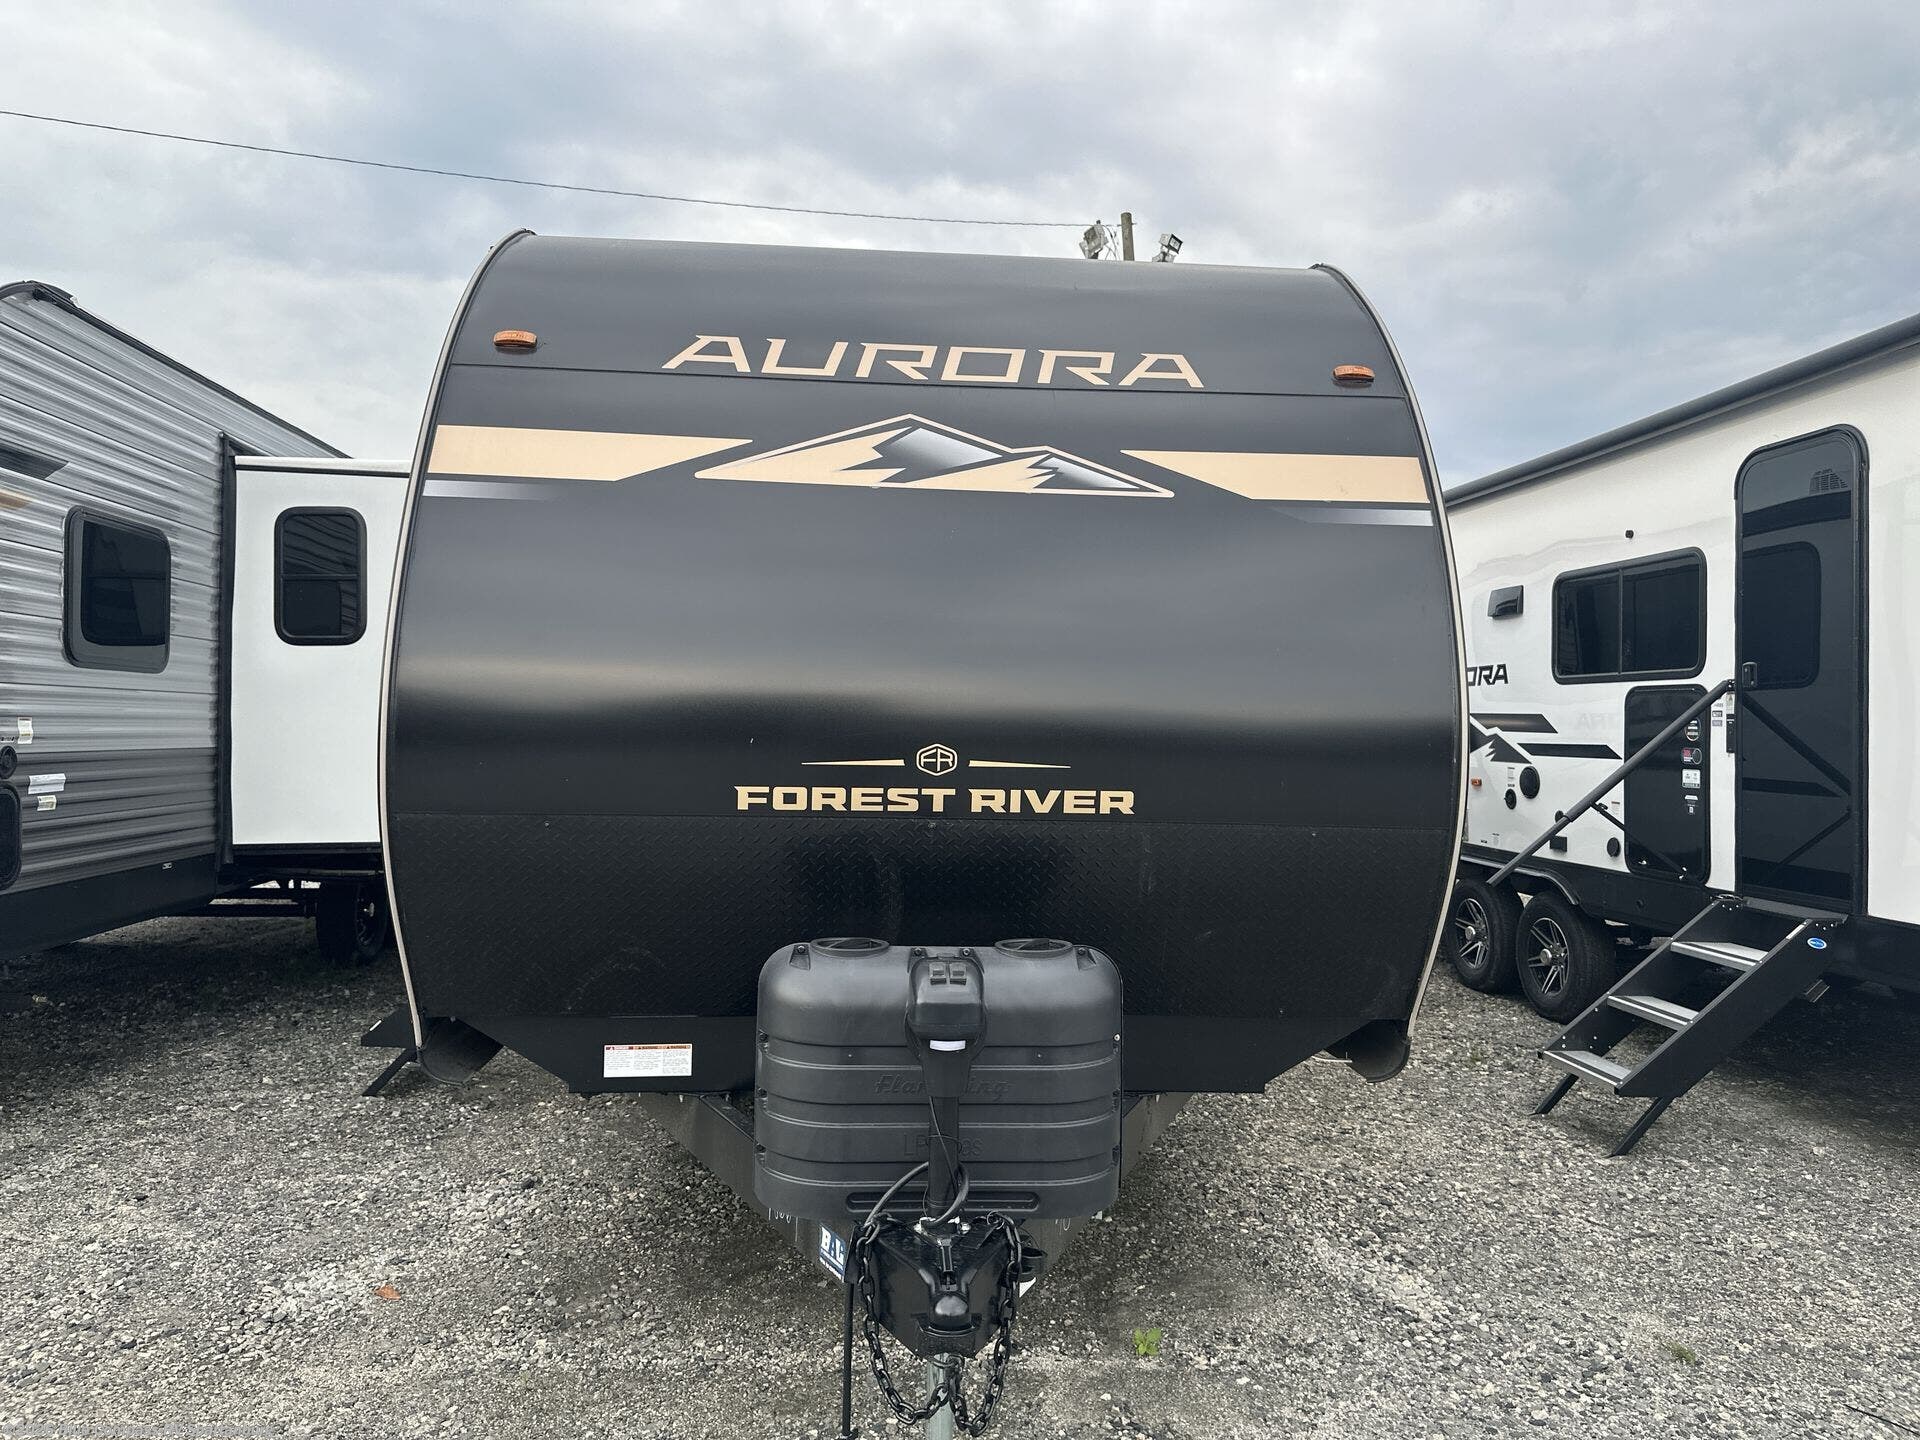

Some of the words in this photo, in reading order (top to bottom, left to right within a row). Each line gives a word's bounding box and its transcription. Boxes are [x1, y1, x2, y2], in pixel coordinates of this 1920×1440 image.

[661, 334, 1205, 389] AURORA
[734, 785, 956, 813] FOREST
[968, 788, 1136, 815] RIVER
[964, 1073, 1012, 1102] ing
